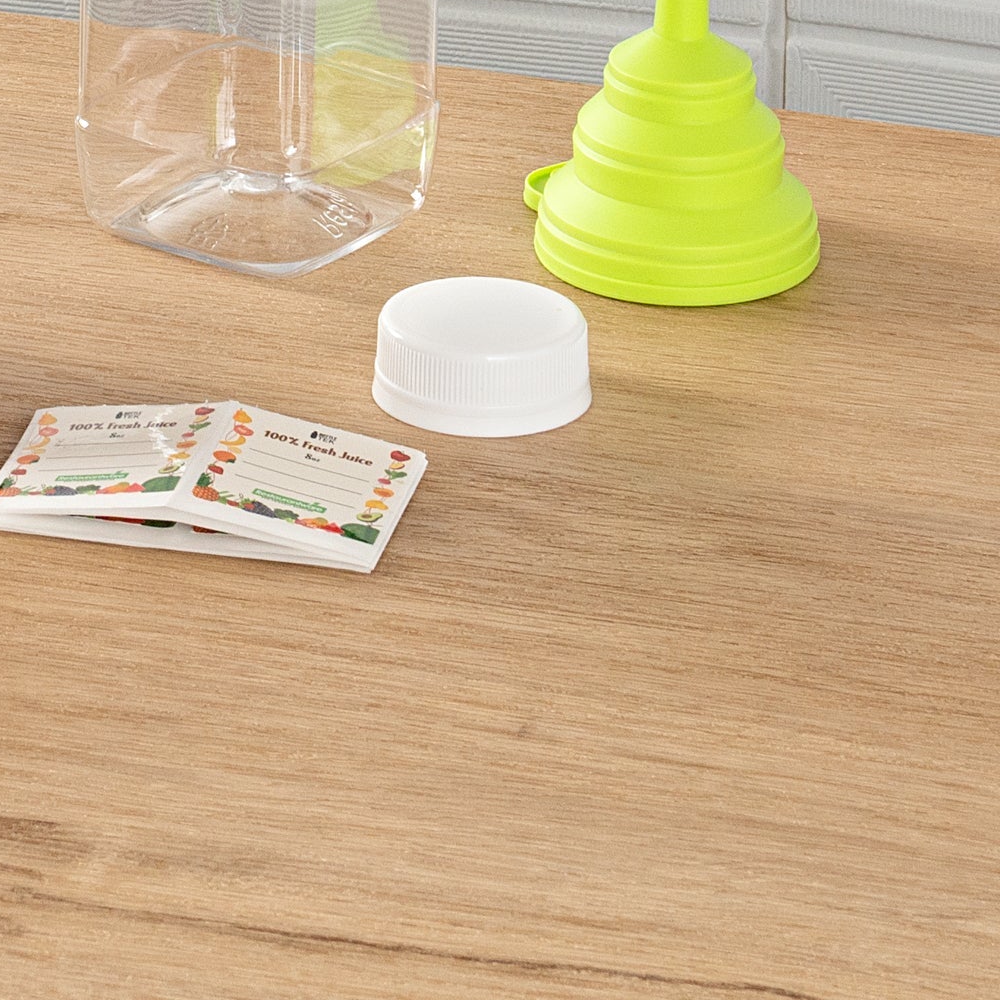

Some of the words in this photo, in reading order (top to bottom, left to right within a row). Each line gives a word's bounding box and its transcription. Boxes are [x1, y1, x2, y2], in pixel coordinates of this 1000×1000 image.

[69, 422, 104, 431] 100%
[107, 421, 141, 430] Fresh
[143, 420, 178, 430] Juice
[264, 430, 299, 447] 100%
[302, 441, 337, 457] Fresh
[338, 451, 373, 466] Juice
